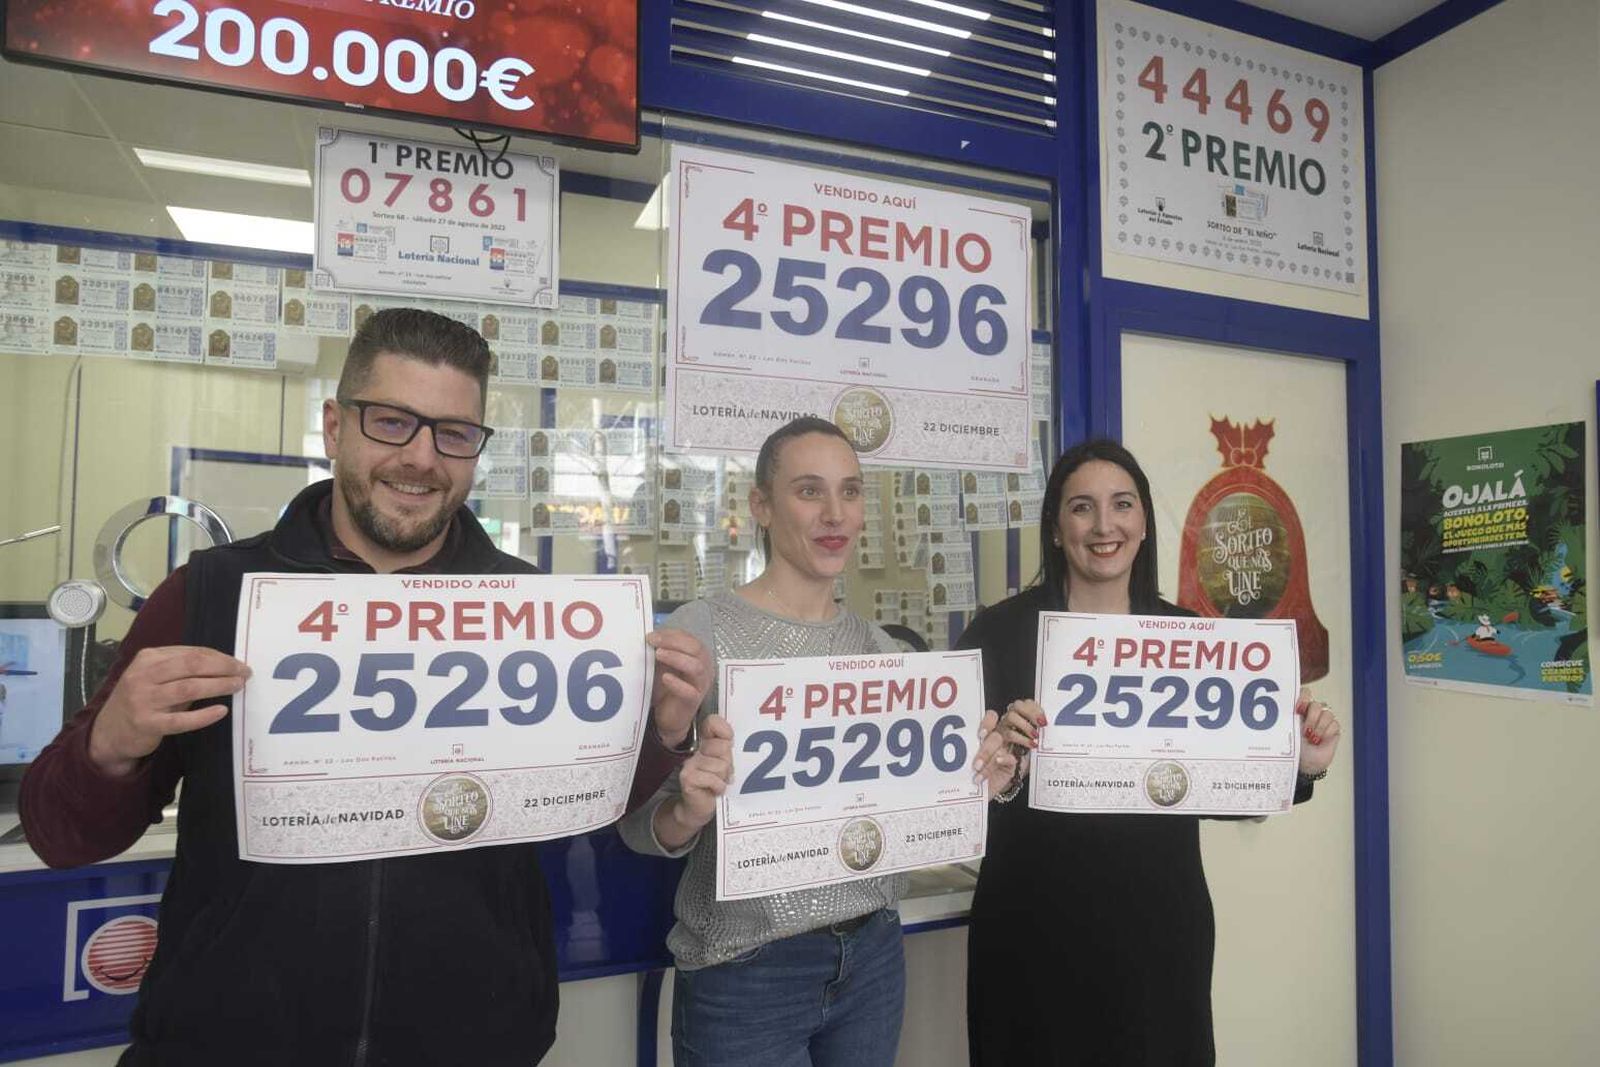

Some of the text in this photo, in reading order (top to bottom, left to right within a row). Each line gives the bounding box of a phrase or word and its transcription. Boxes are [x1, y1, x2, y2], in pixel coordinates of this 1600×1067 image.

[148, 0, 535, 111] 200.000€
[1138, 55, 1330, 143] 44469
[396, 144, 513, 179] PREMIO
[1182, 128, 1326, 196] PREMIO
[340, 168, 525, 222] 07861
[814, 183, 917, 210] VENDIDO AQUÍ
[722, 198, 992, 273] 4º PREMIO
[1233, 227, 1242, 235] DE
[437, 254, 479, 266] Nacional
[699, 249, 1008, 356] 25296
[924, 422, 1000, 437] 22 DICIEMBRE
[1442, 469, 1527, 508] OJALÁ
[401, 577, 516, 590] VENDIDO AQUÍ
[298, 600, 604, 642] 4º PREMIO
[1139, 620, 1215, 632] VENDIDO AQUÍ
[828, 656, 904, 671] VENDIDO AQUÍ
[1072, 636, 1271, 671] 4º PREMIO
[269, 649, 625, 735] 25296
[759, 676, 958, 721] 4º PREMIO
[1054, 673, 1280, 731] 25296
[740, 715, 967, 795] 25296
[524, 789, 606, 808] 22 DICIEMBRE
[1212, 781, 1271, 790] 22 DICIEMBRE
[905, 828, 963, 843] 22 DICIEMBRE
